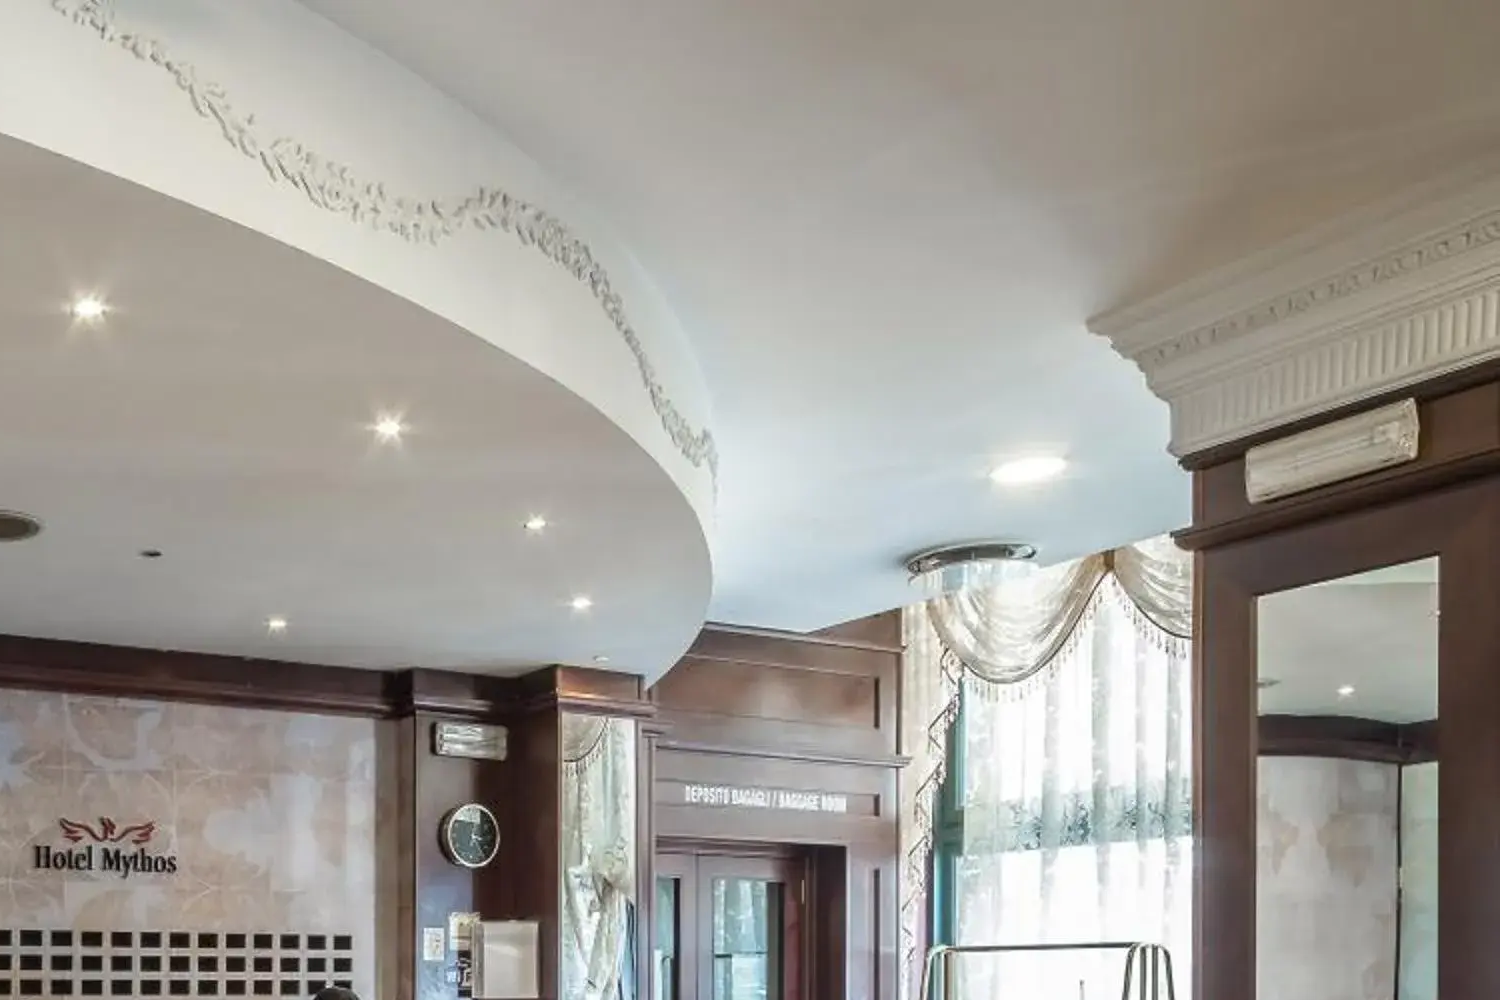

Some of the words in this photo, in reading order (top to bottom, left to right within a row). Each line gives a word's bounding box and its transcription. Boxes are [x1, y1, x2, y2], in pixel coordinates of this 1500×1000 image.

[685, 784, 730, 805] DEPOSITO
[821, 792, 847, 813] ROOM
[33, 844, 93, 871] Hotel
[101, 846, 178, 879] Mythos
